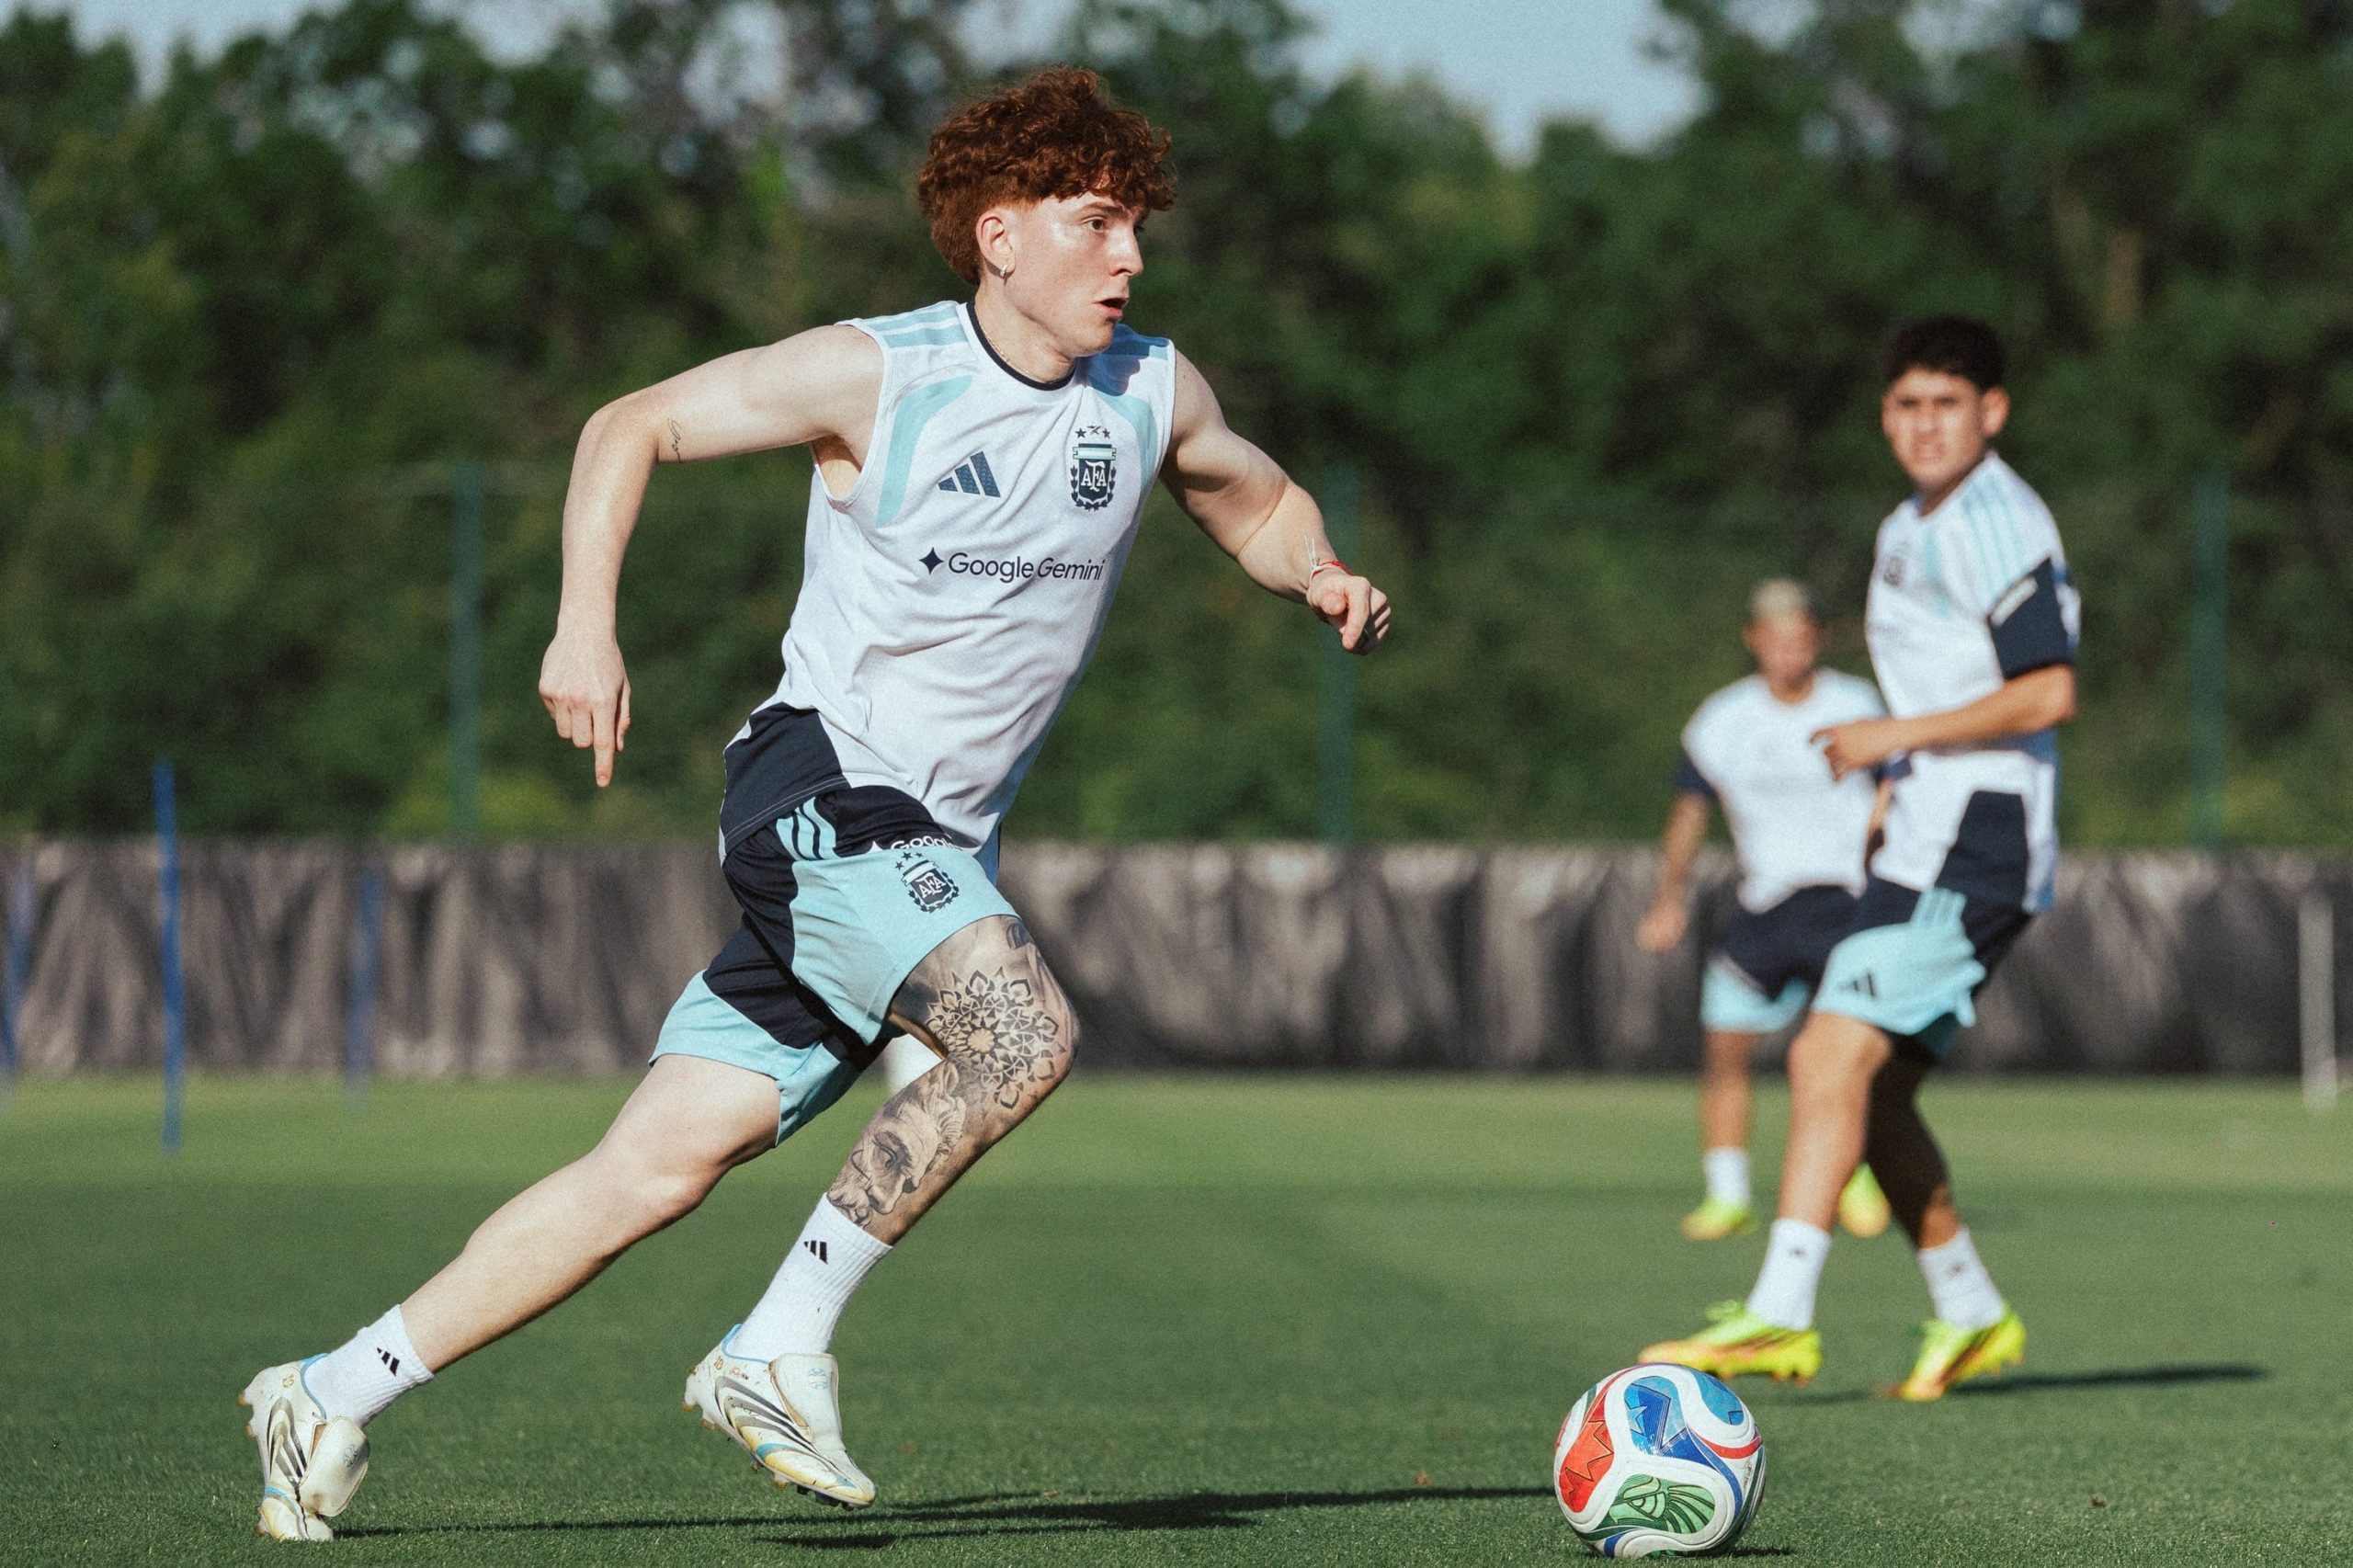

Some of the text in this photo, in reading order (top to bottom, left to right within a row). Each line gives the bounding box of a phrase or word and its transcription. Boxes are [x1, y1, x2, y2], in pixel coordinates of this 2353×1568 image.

[1080, 460, 1107, 492] AFA
[949, 552, 1105, 583] Google Gemini
[890, 833, 957, 850] Goog
[915, 872, 947, 898] AFA
